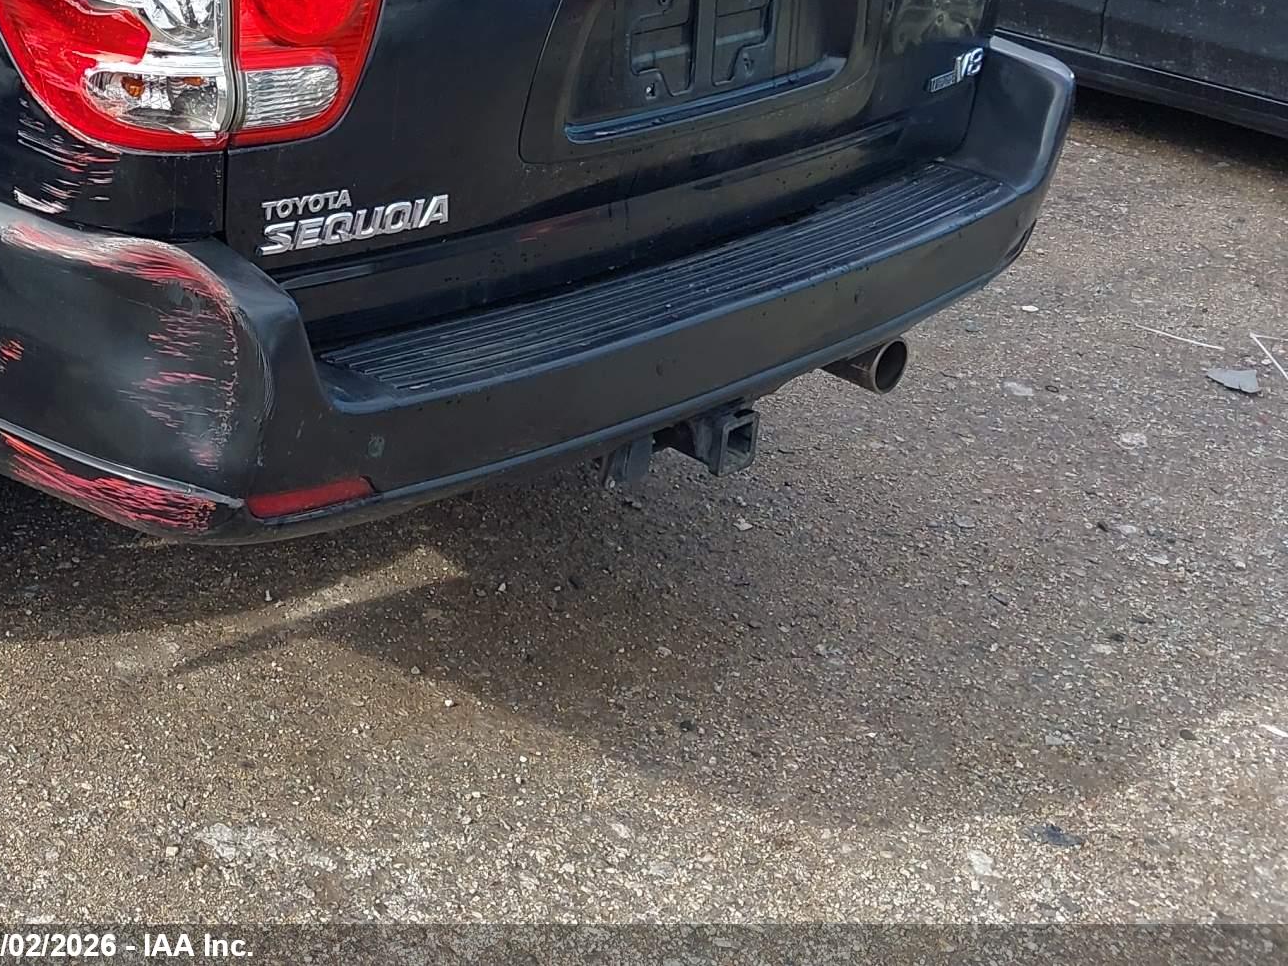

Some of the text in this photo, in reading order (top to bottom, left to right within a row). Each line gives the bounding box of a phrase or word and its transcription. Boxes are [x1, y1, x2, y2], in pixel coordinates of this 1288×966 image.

[954, 47, 984, 83] V8
[261, 189, 352, 221] TOYOTA
[257, 194, 450, 257] SEQUOIA
